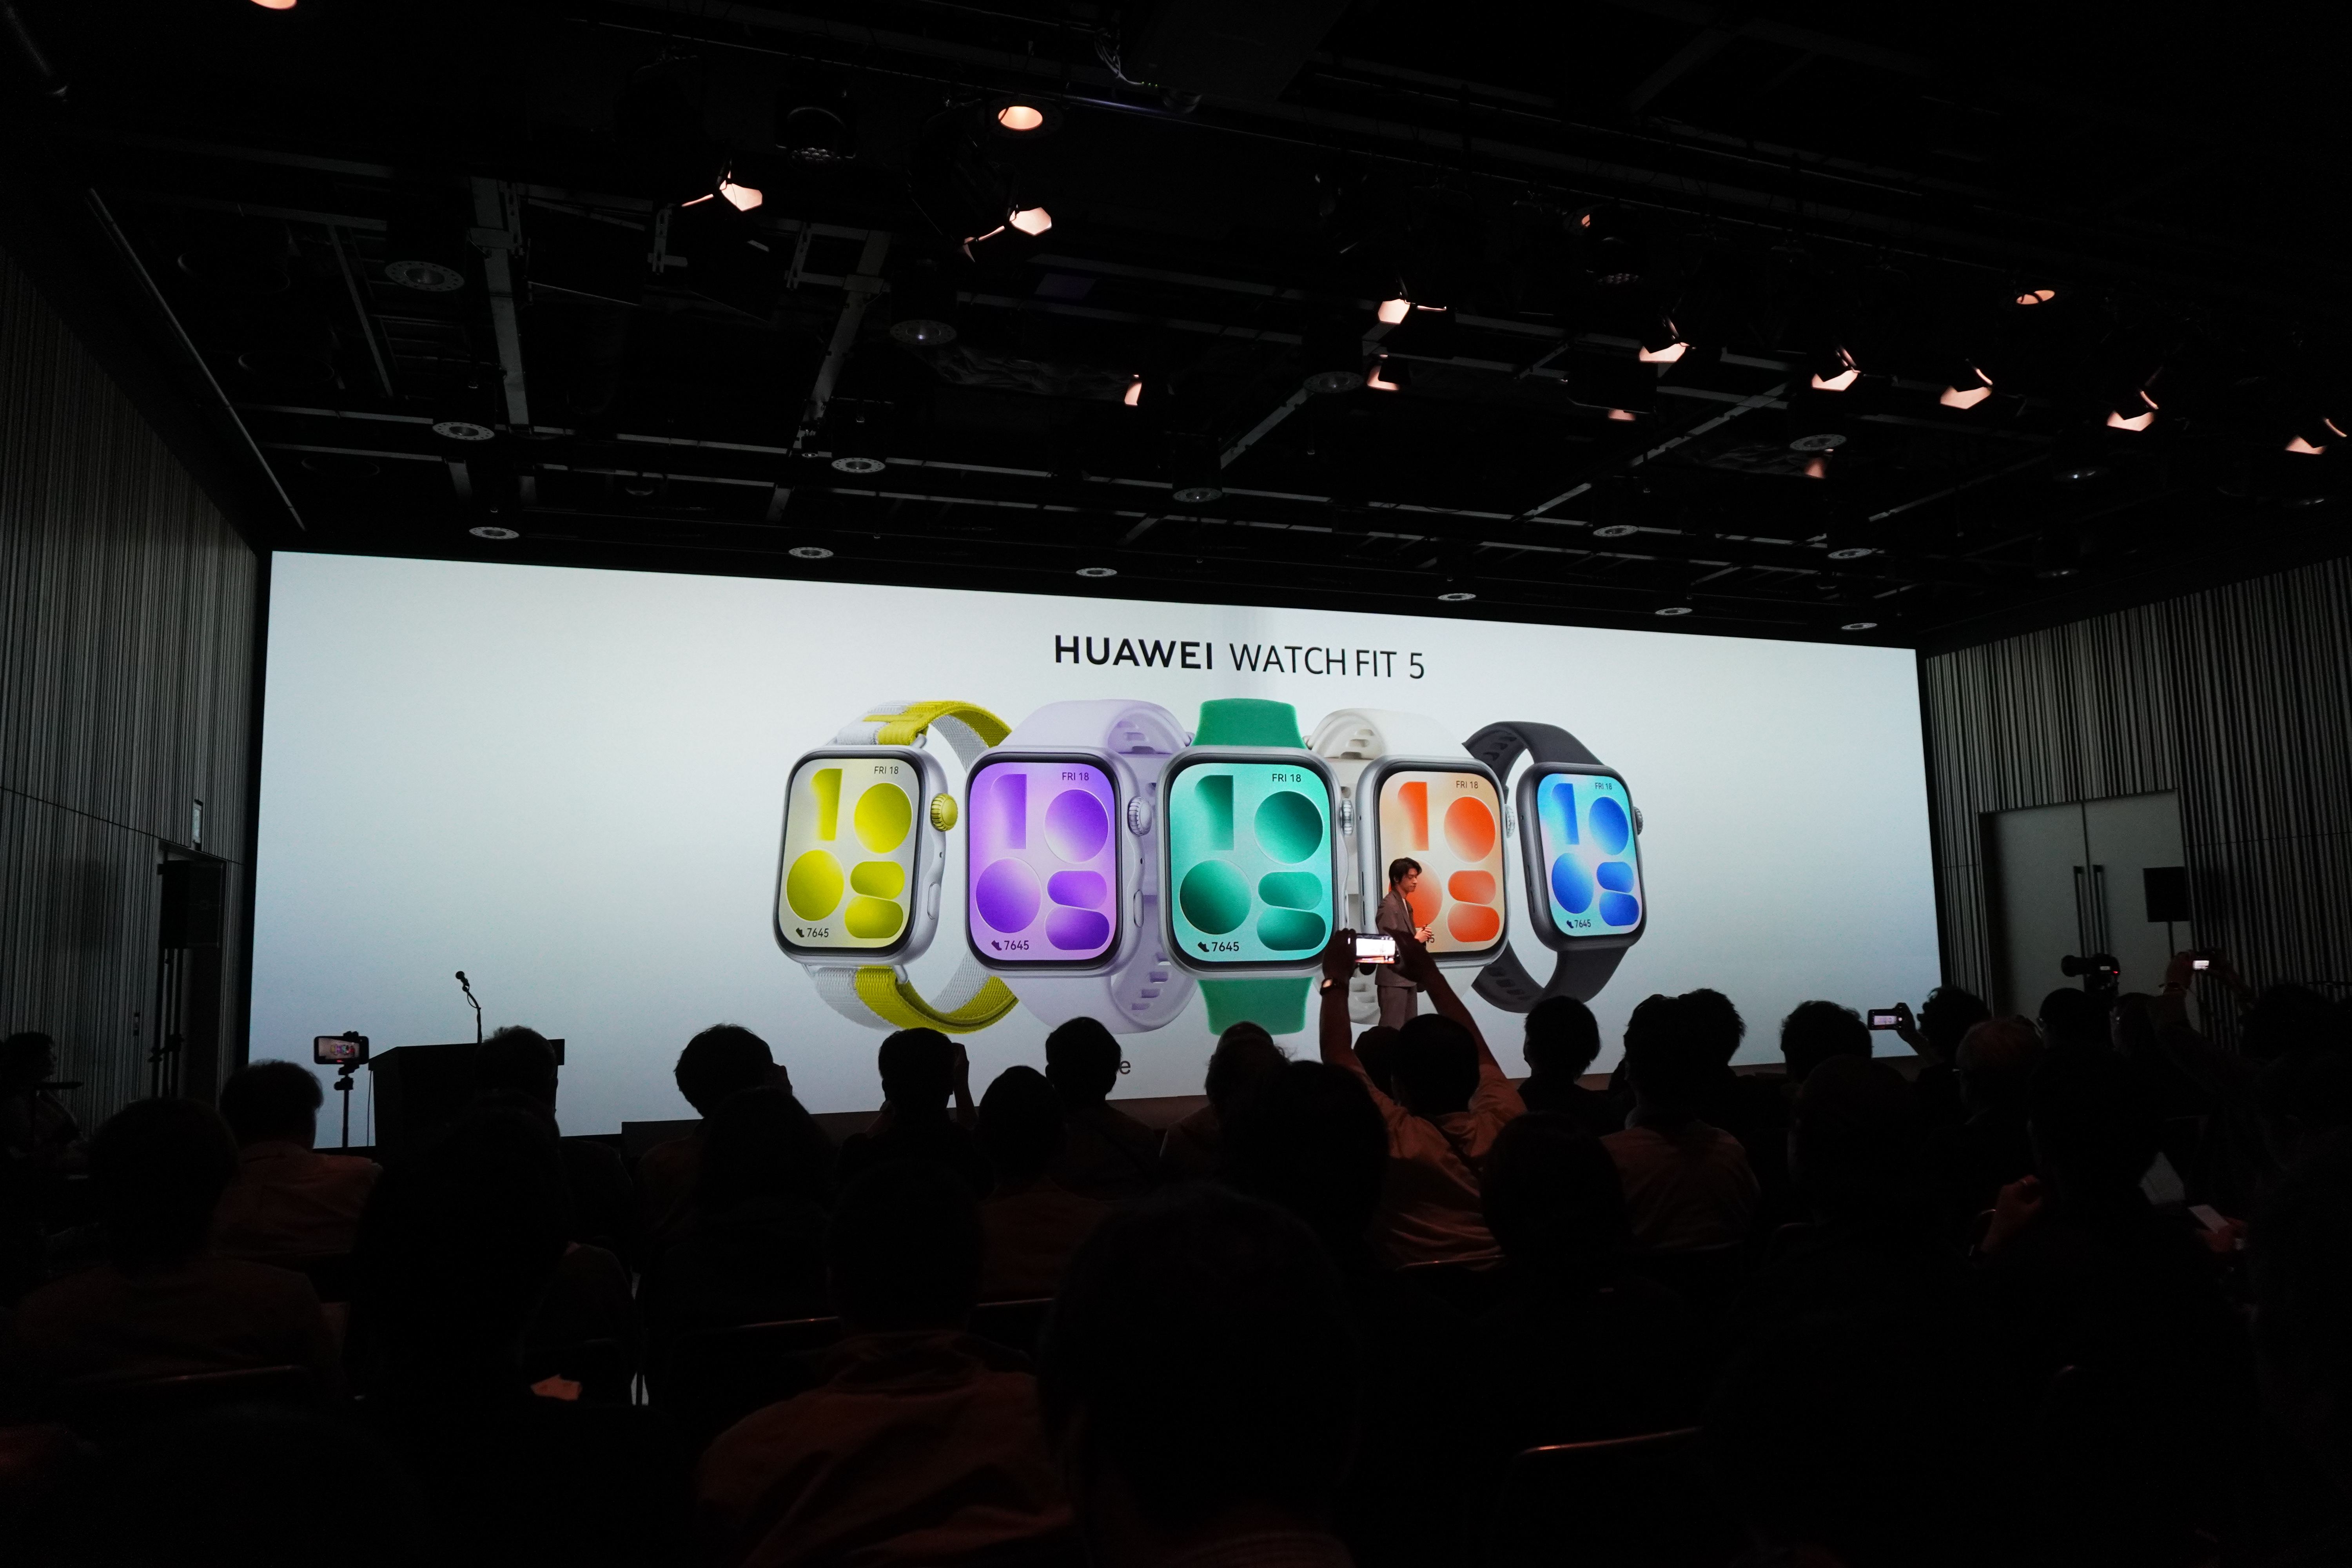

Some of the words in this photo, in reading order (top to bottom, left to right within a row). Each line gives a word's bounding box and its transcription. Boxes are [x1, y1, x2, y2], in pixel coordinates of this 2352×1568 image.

[1055, 635, 1212, 670] HUAWEI
[1229, 643, 1346, 675] WATCH
[1356, 650, 1397, 677] FIT
[1410, 652, 1424, 679] 5
[874, 766, 887, 774] FRI
[889, 766, 899, 775] 18
[1062, 772, 1076, 781] FRI
[1078, 772, 1089, 781] 18
[1272, 773, 1287, 782] FRI
[1290, 773, 1301, 783] 18
[1456, 780, 1468, 788] FRI
[1469, 780, 1479, 789] 18
[1574, 918, 1592, 928] 7645
[807, 927, 829, 938] 7645
[1004, 940, 1029, 951] 7645
[1212, 942, 1240, 952] 7645
